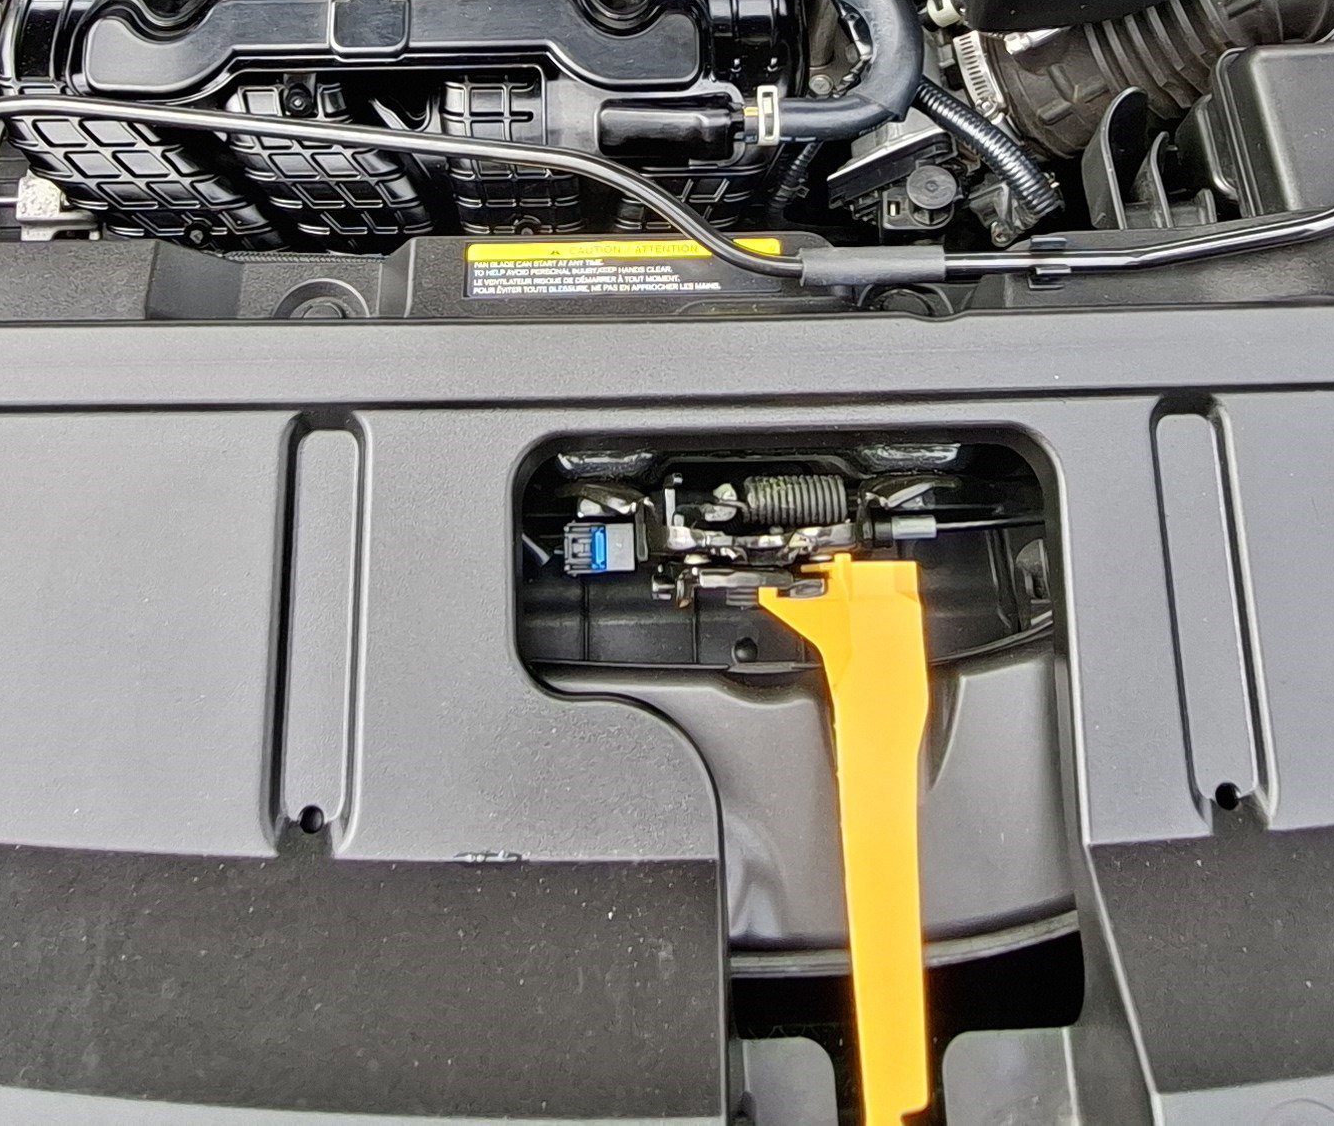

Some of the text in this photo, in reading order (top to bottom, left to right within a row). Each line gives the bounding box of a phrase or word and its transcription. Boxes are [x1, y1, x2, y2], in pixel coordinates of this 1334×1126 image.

[569, 246, 621, 255] CAUTION
[635, 245, 698, 254] ATTENTION
[619, 266, 645, 274] HANDS
[483, 278, 532, 286] VENTILATEUR
[533, 277, 562, 285] RISQUE
[575, 275, 617, 284] DÉMARRER
[646, 275, 681, 283] MOMENT.
[497, 286, 522, 294] ÉVITER
[591, 284, 602, 292] NE
[631, 283, 678, 291] APPROCHER
[680, 282, 694, 290] LES
